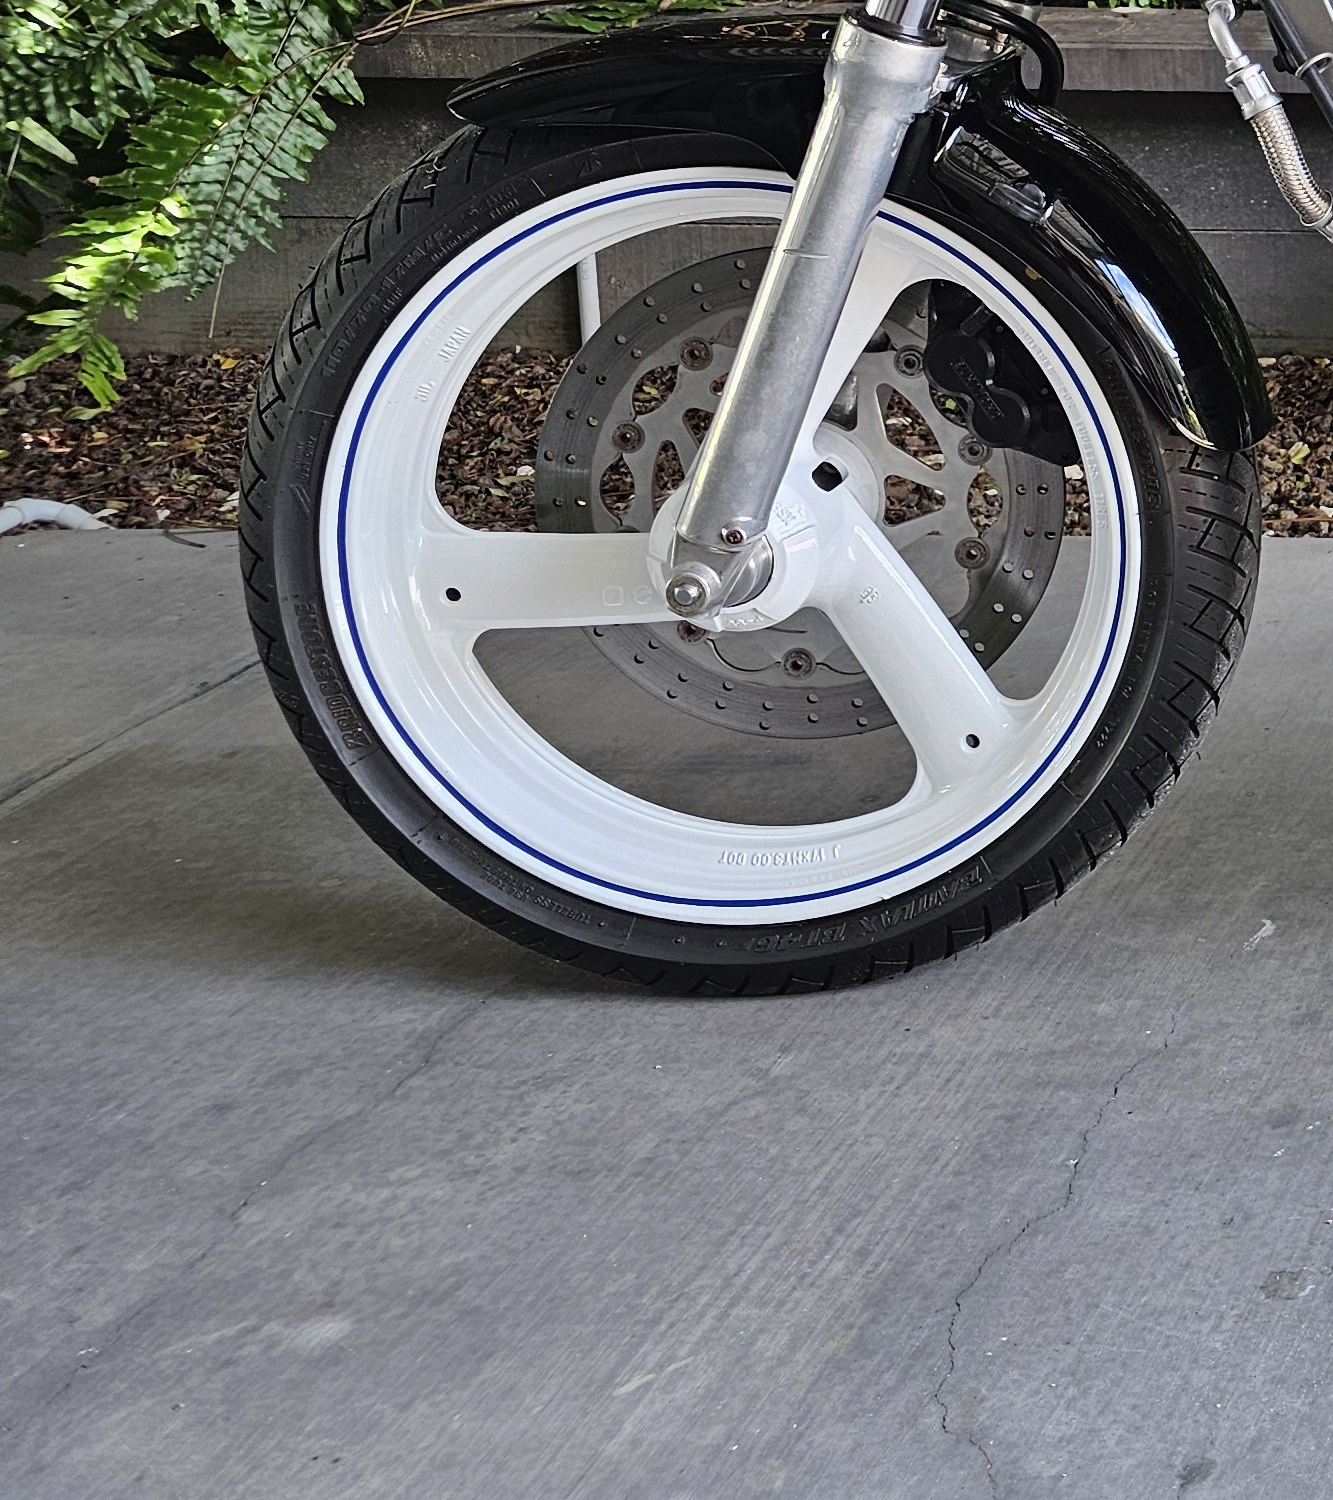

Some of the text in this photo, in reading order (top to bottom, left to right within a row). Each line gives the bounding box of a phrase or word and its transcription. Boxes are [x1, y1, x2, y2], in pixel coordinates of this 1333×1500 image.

[437, 325, 470, 364] JAPAN
[296, 604, 370, 750] BRIDGESTONE
[718, 850, 746, 865] DOT
[534, 895, 590, 924] TUBELESS
